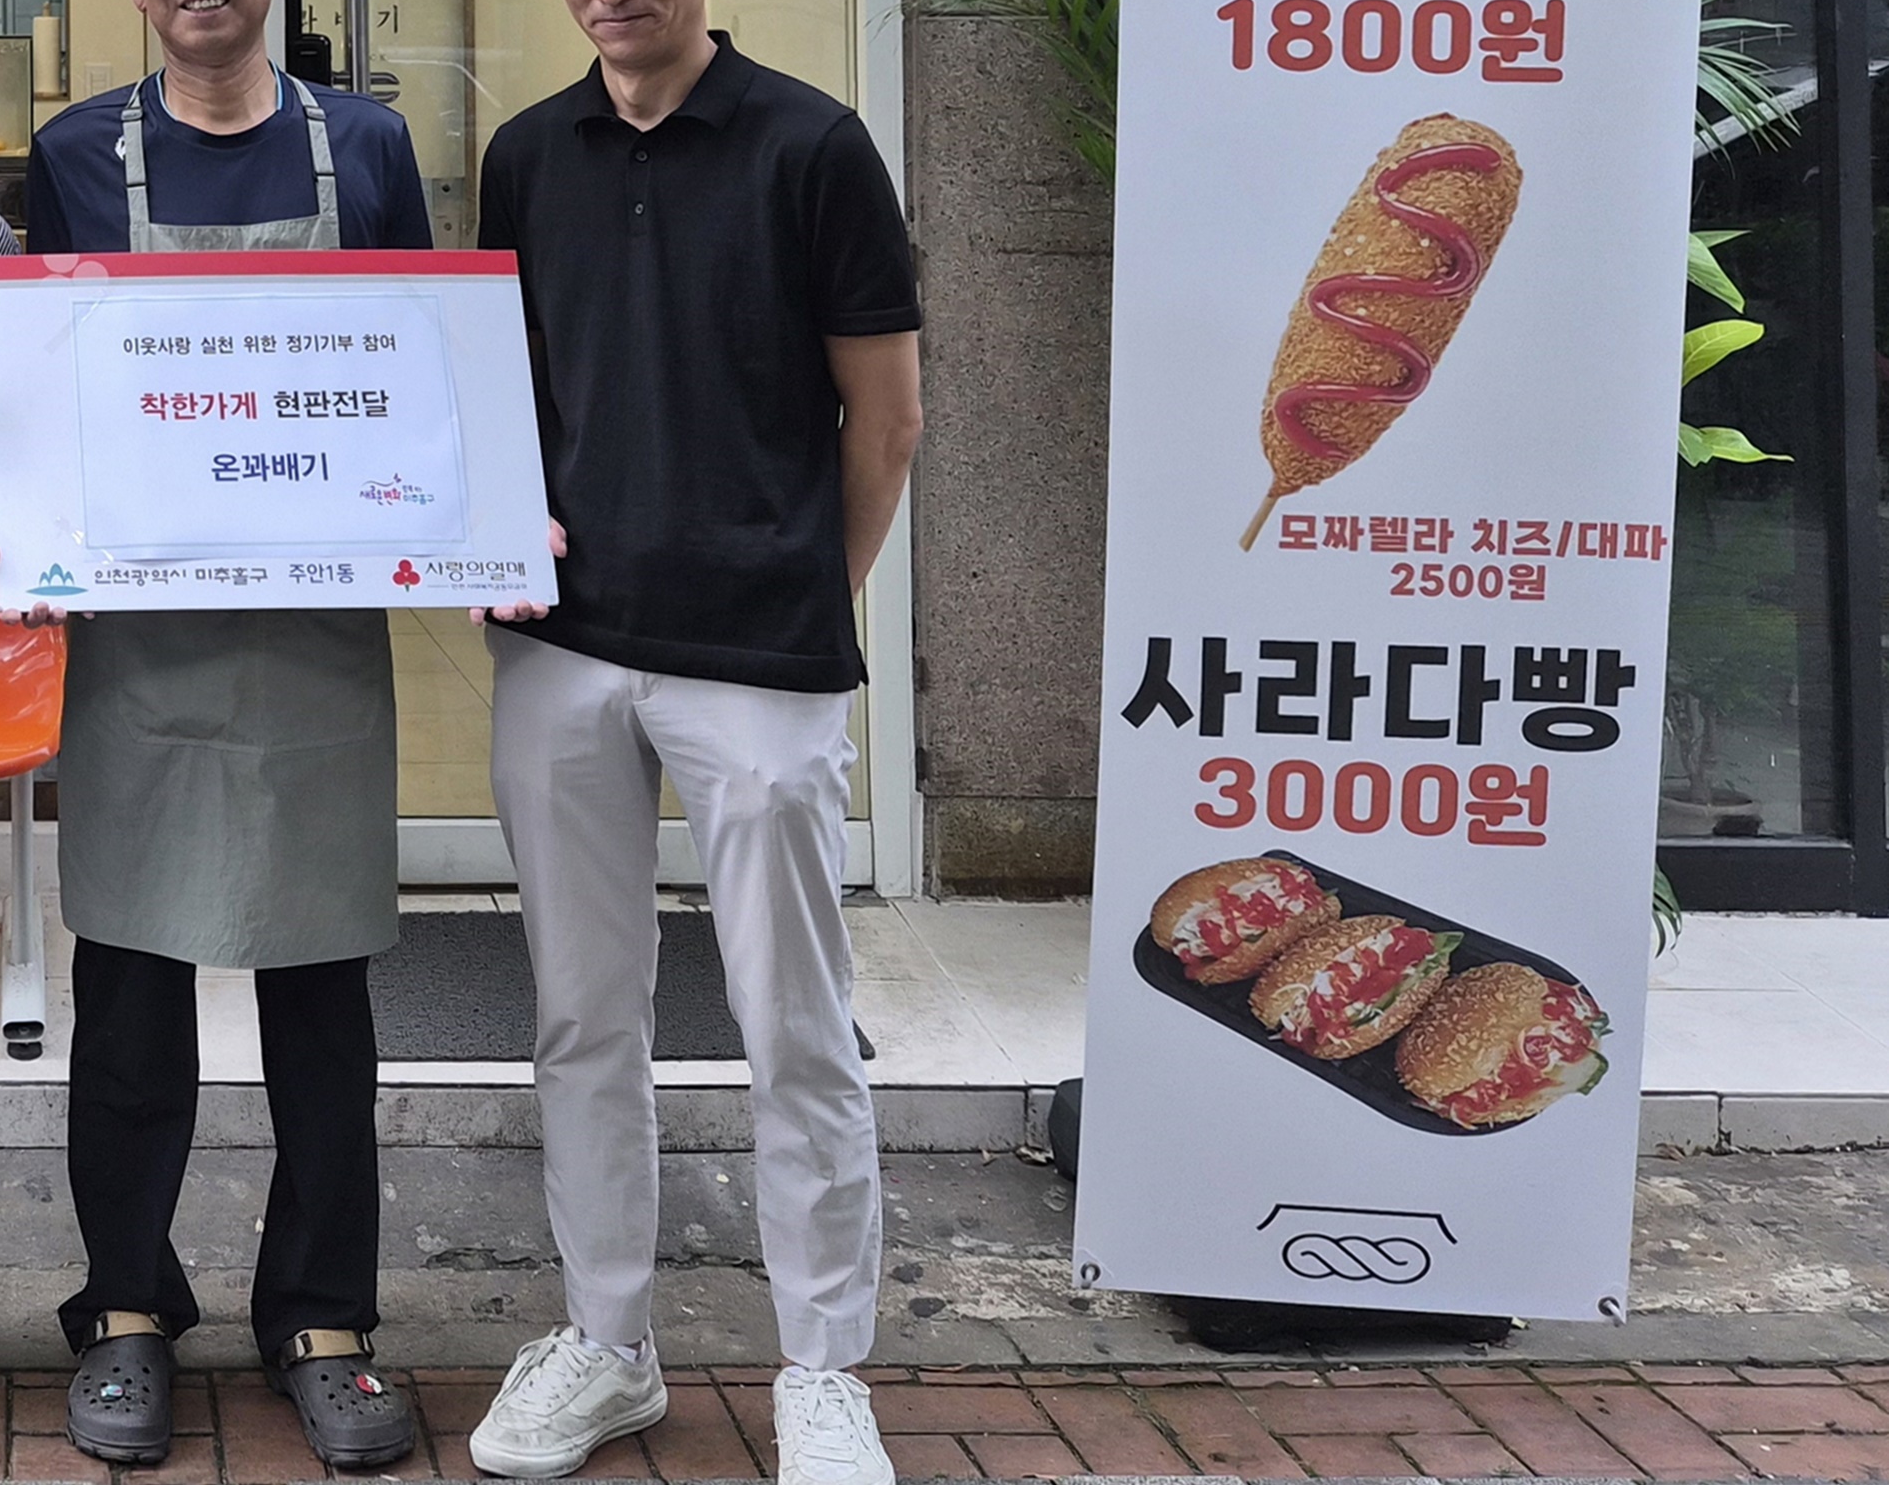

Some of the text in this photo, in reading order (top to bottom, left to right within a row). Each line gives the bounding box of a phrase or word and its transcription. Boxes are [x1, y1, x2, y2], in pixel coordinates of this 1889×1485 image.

[122, 333, 397, 357] 이웃사랑 실천 위한 정기기부 참여
[139, 389, 390, 421] 착한가게 현판전달
[210, 452, 330, 483] 온꽈배기
[1278, 513, 1668, 562] 모짜렐라 치즈/대파
[93, 562, 355, 587] 인천광역시 미추홀구 주안1동
[425, 560, 527, 584] 사랑의열매
[1389, 562, 1547, 601] 2500원
[1119, 635, 1637, 753] 사라다빵
[1193, 756, 1551, 847] 3000원
